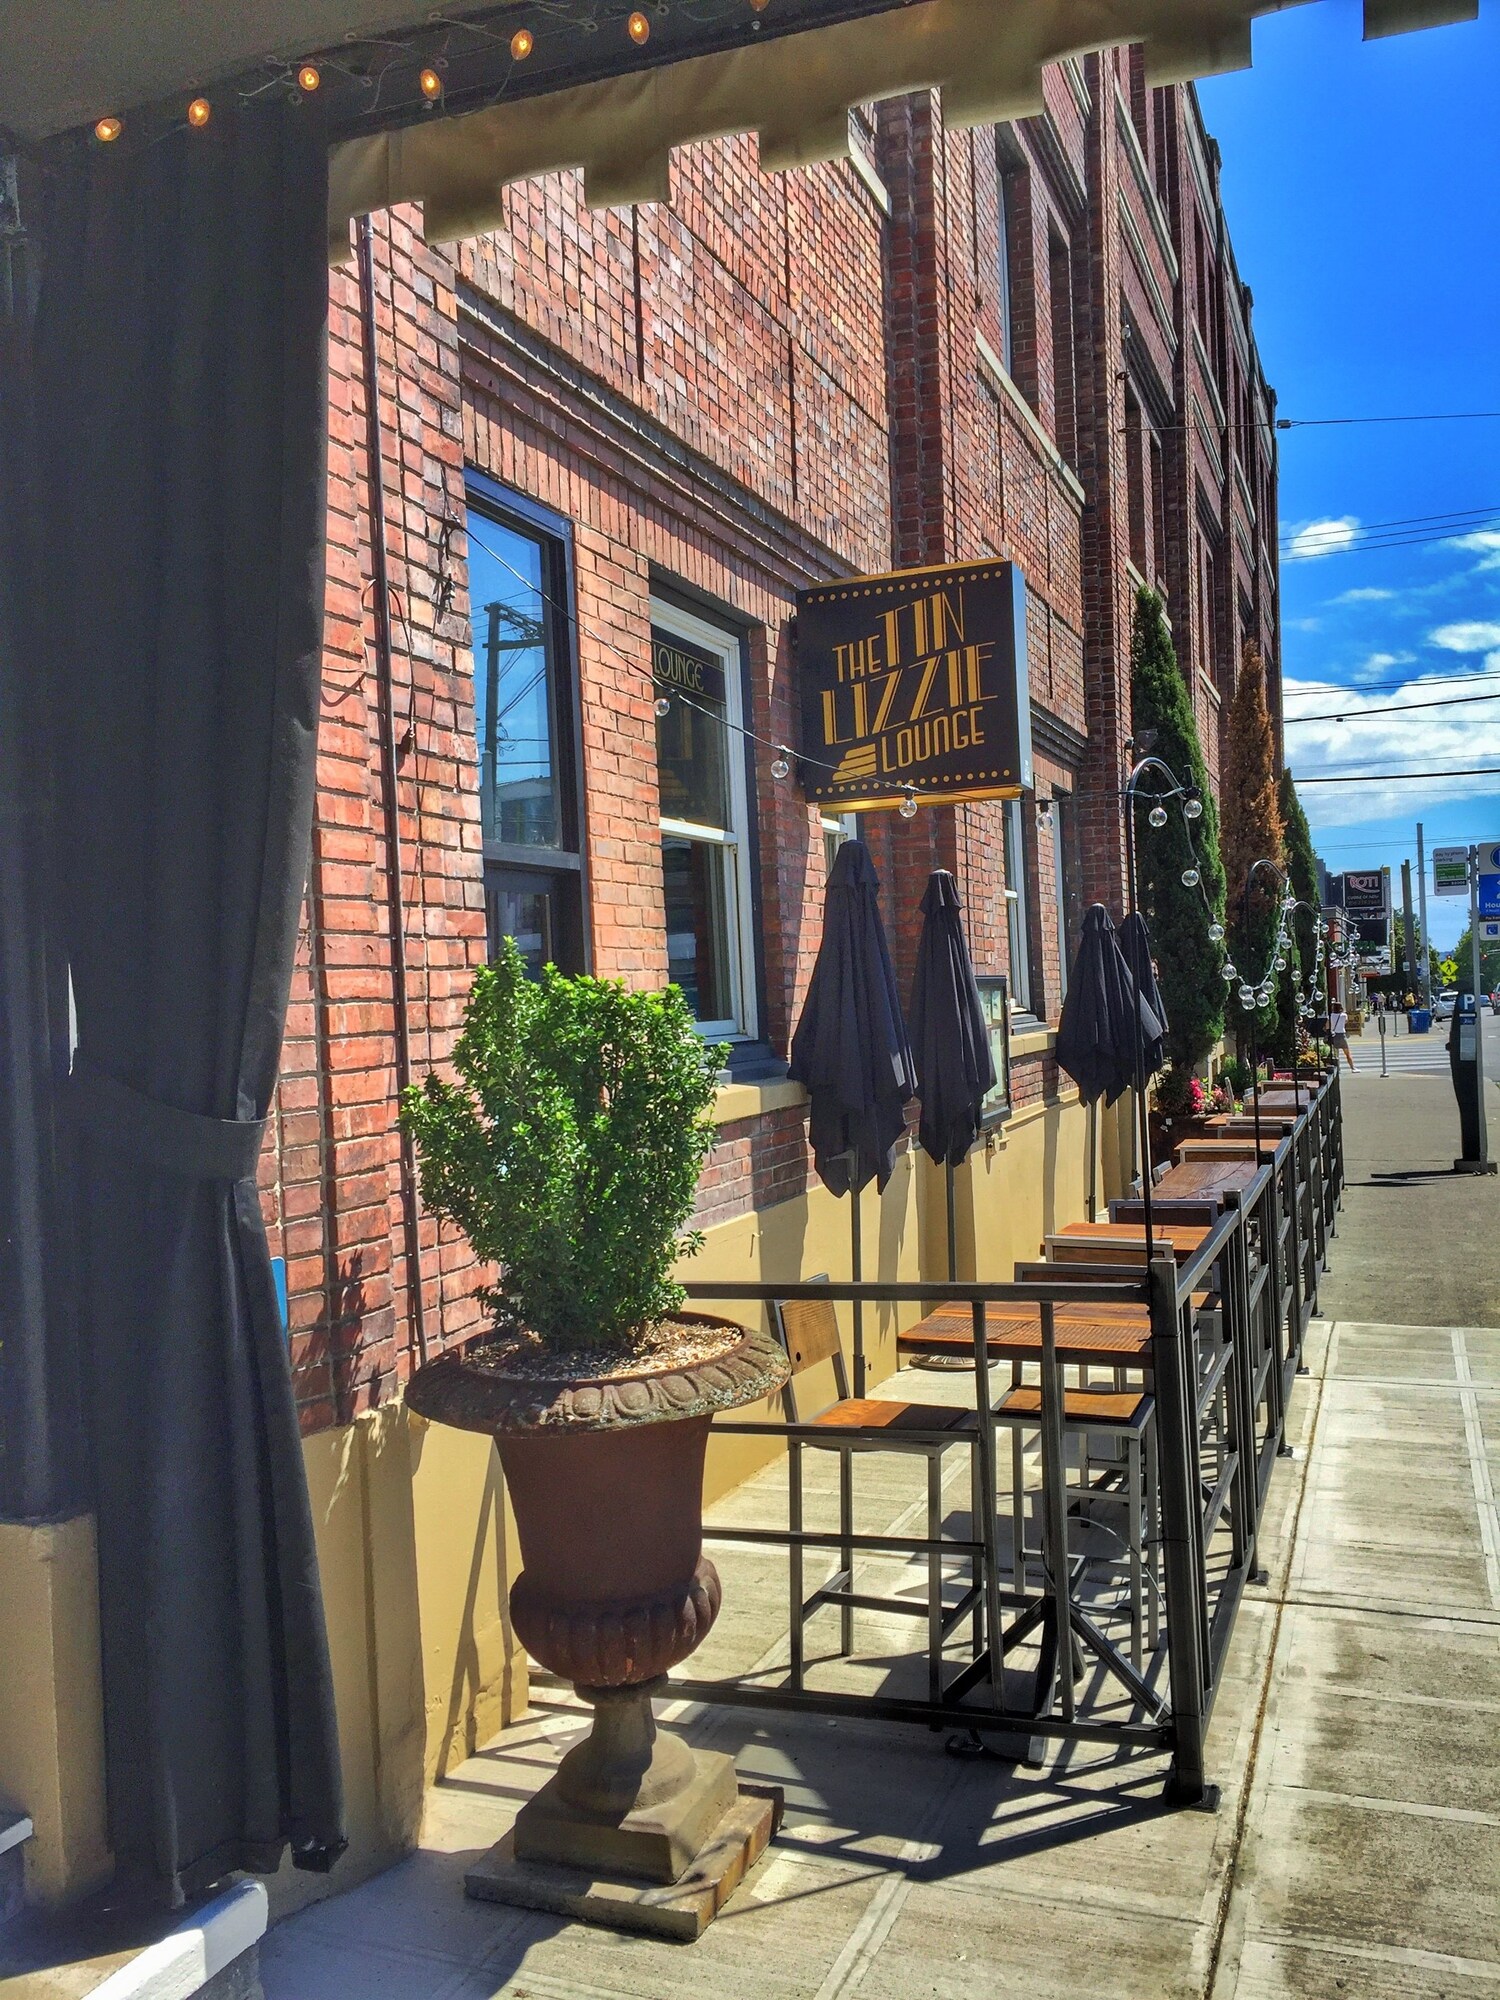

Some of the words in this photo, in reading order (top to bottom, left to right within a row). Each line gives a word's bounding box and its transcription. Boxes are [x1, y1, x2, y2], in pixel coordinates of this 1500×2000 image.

[832, 635, 881, 683] THE
[875, 586, 965, 667] TIN
[653, 644, 705, 692] LOUNGE
[820, 642, 998, 746] LIZZIE
[882, 706, 985, 773] LOUNGE
[1347, 875, 1379, 892] ROTI
[1463, 994, 1475, 1010] P
